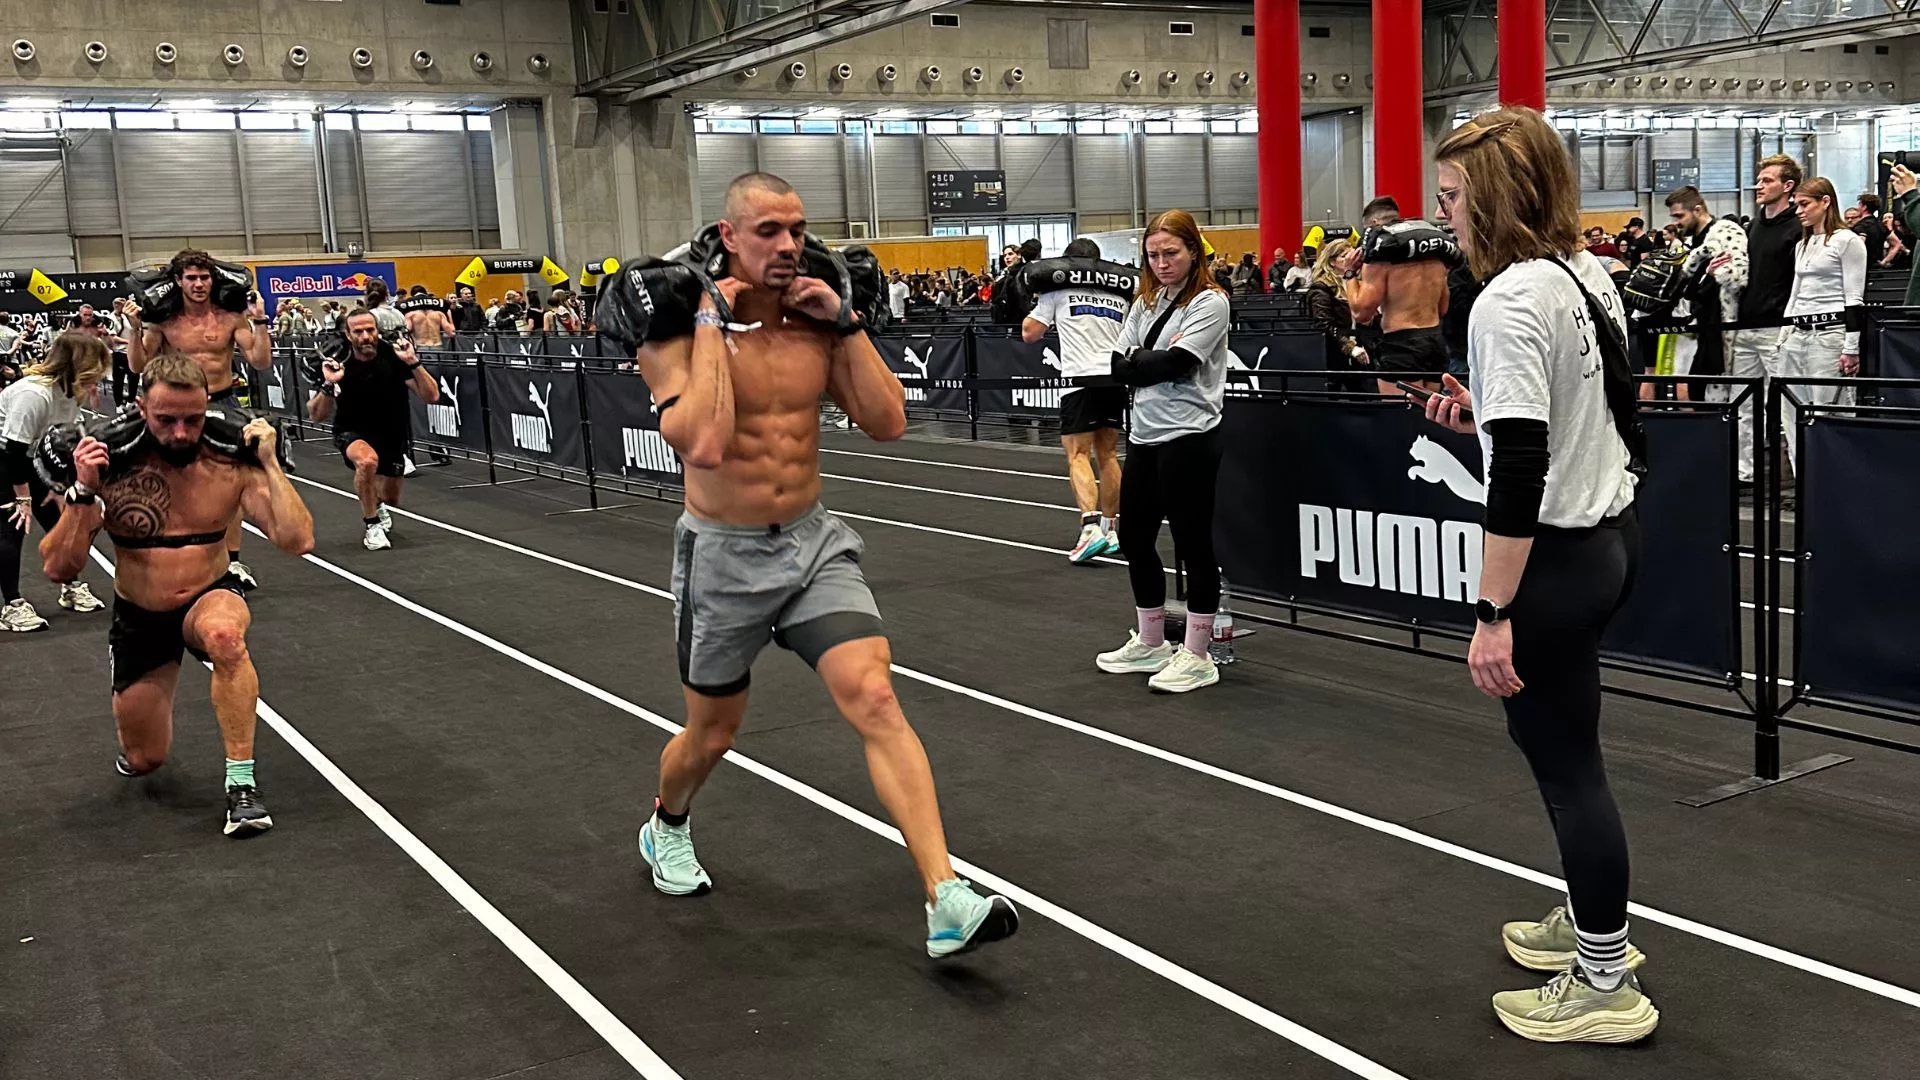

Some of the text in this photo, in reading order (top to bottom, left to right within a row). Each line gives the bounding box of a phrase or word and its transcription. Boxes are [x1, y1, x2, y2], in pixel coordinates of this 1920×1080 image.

[494, 260, 533, 269] BURPEES
[69, 281, 117, 290] HYROX
[270, 275, 334, 294] Red Bull
[1069, 270, 1132, 290] CENTR
[37, 286, 51, 295] 07
[1068, 295, 1124, 310] EVERYDAY
[1792, 313, 1838, 324] HYROX
[1647, 326, 1686, 334] HYROX
[935, 379, 963, 388] HYROX
[1040, 378, 1074, 387] HYROX
[427, 404, 458, 437] PUMA
[511, 412, 549, 453] PUMA
[1299, 503, 1484, 604] PUMA
